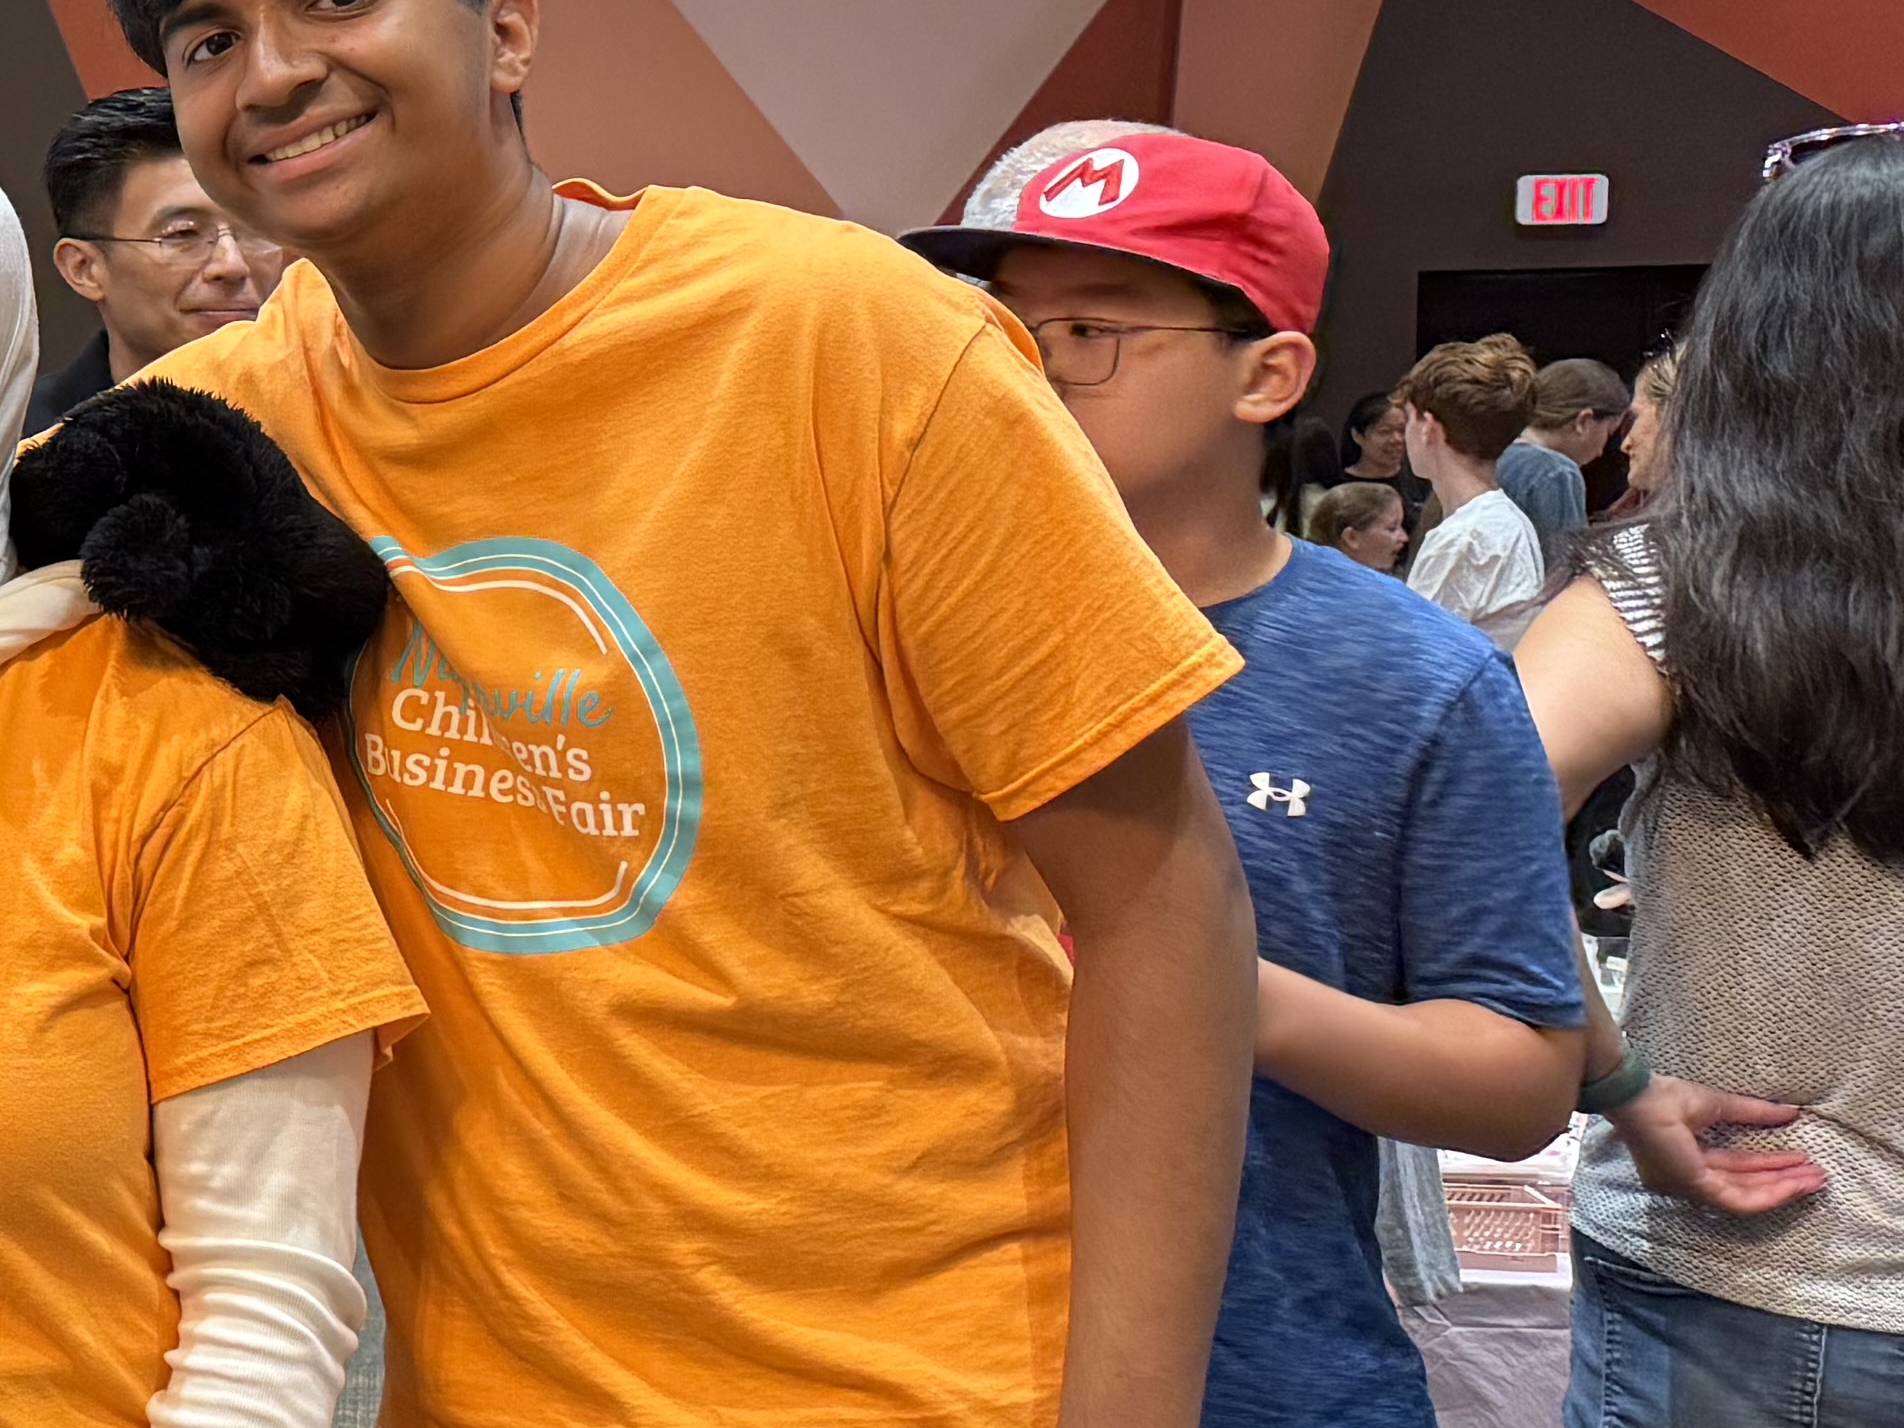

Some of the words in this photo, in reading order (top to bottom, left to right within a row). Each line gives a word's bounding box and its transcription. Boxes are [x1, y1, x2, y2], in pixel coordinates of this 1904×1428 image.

[1043, 157, 1125, 204] M
[1533, 177, 1598, 223] EXIT
[541, 785, 646, 837] Fair
